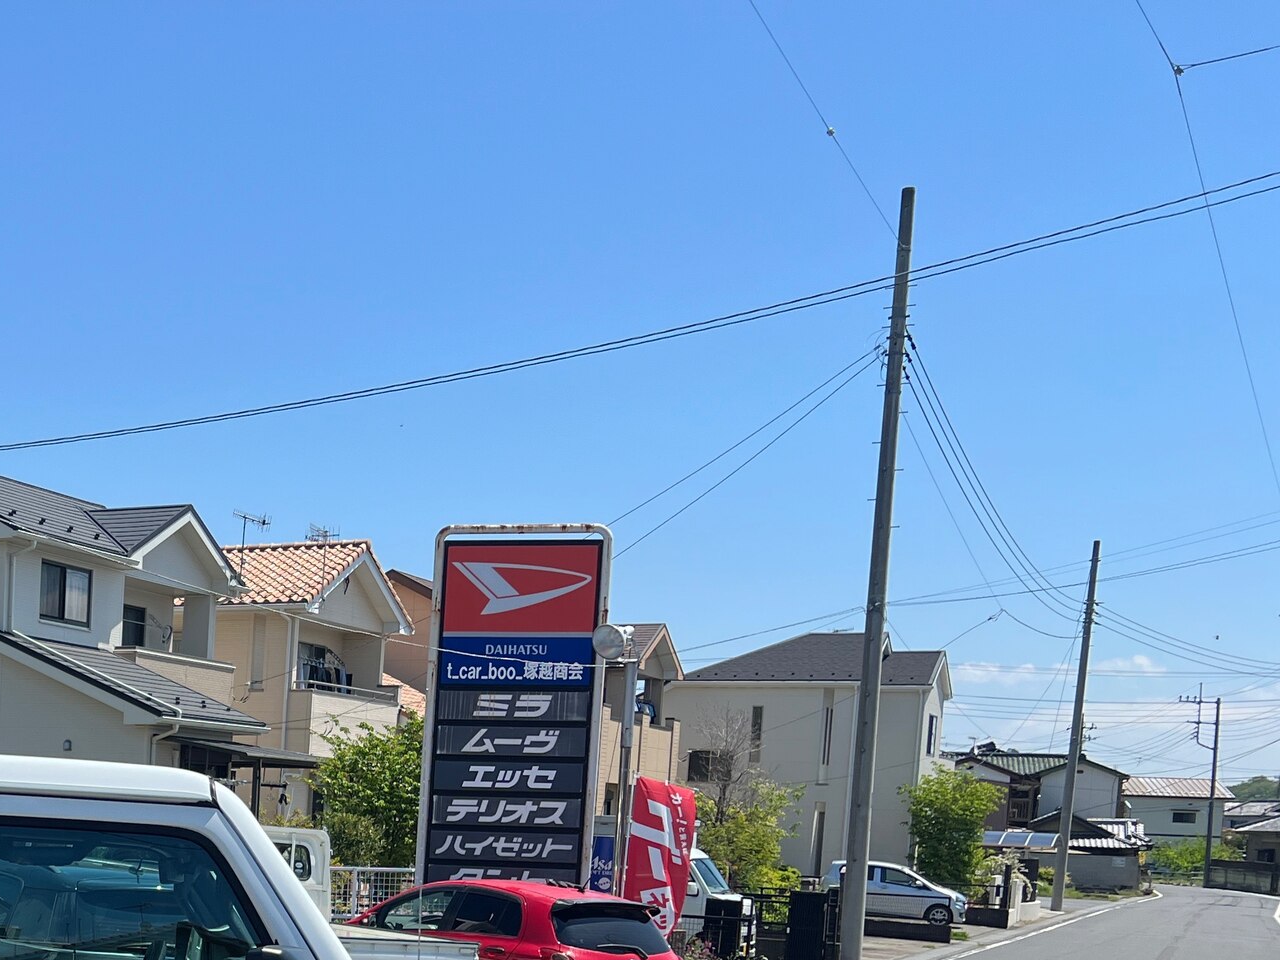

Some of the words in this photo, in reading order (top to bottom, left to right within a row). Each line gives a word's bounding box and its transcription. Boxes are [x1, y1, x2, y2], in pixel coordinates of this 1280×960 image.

[485, 644, 548, 656] DAIHATSU
[472, 694, 553, 718] ミラ
[460, 728, 561, 753] ムーヴ
[461, 765, 557, 789] エッセ
[446, 799, 568, 825] テリオス
[435, 835, 573, 858] ハイゼット
